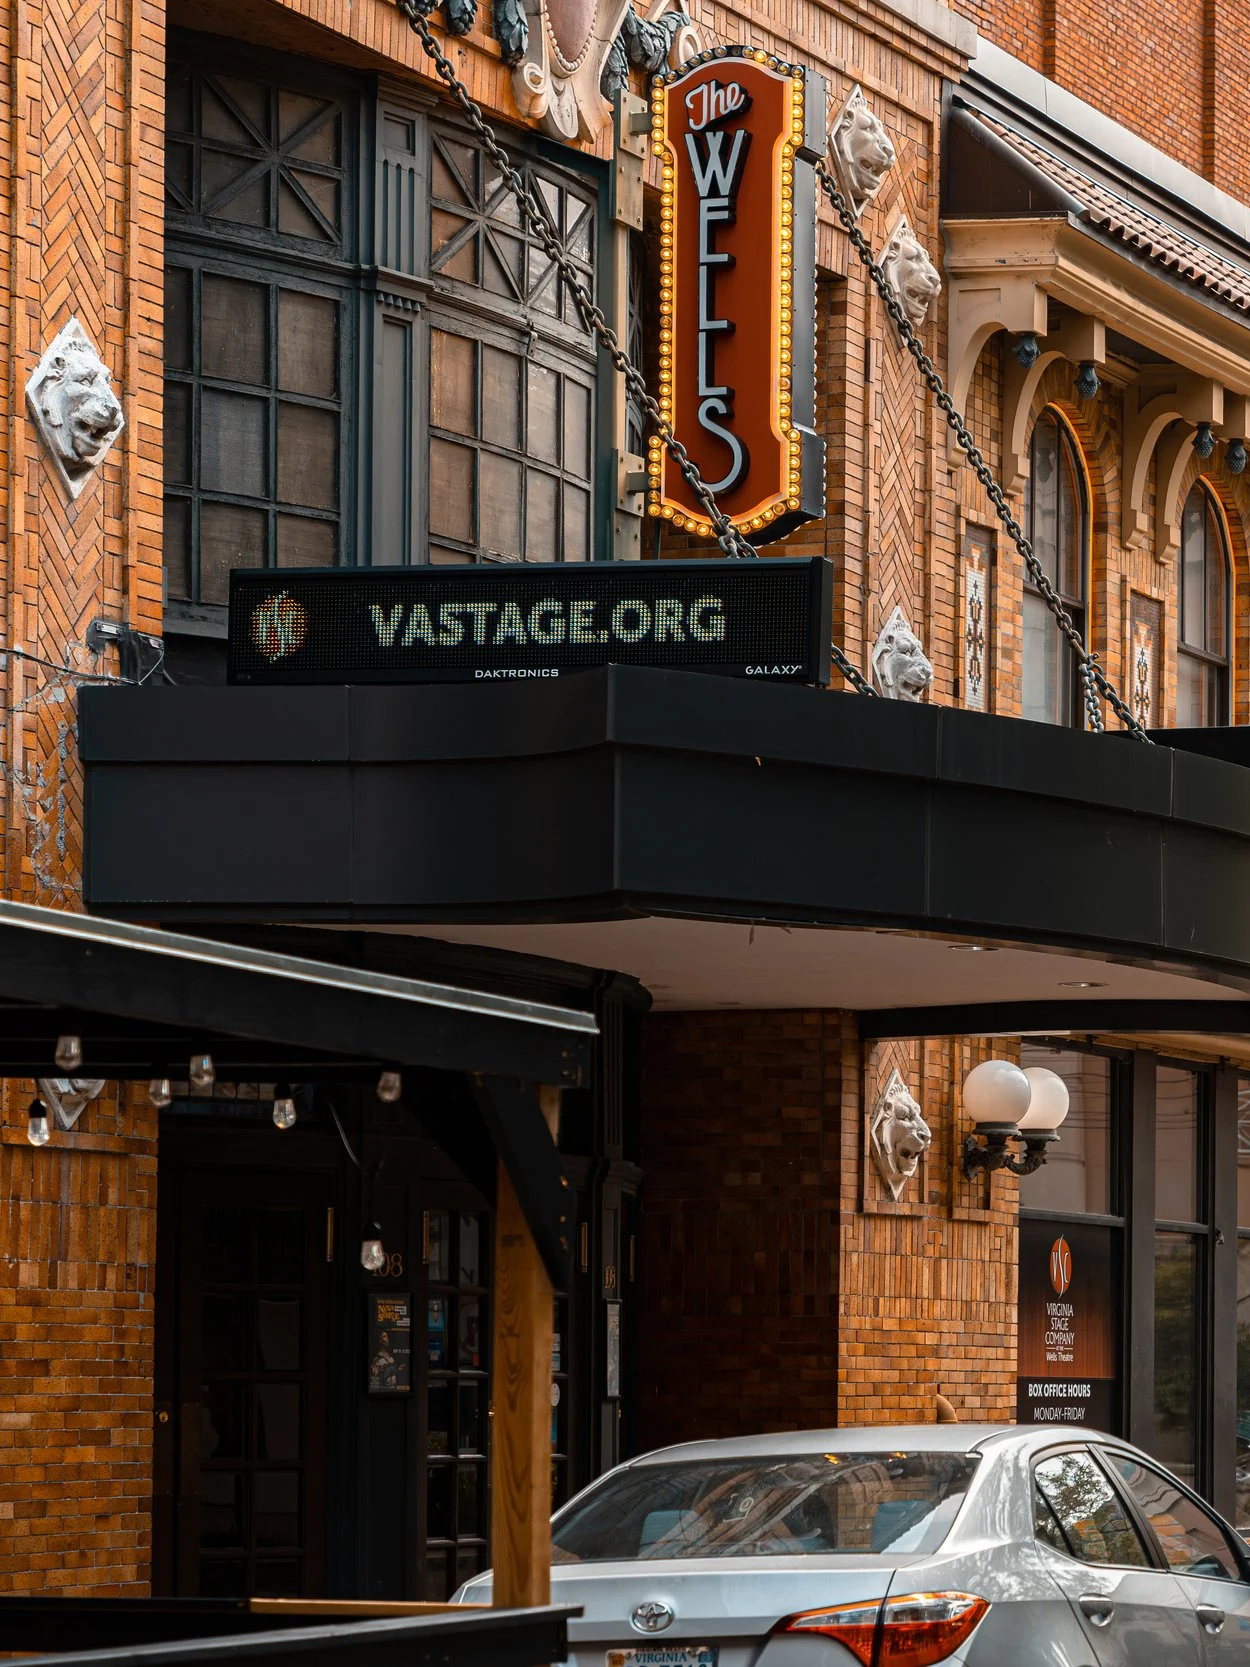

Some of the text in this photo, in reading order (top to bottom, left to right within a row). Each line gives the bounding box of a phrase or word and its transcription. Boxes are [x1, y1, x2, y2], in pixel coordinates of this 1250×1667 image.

[685, 80, 745, 130] The
[685, 129, 746, 493] WELLS
[369, 594, 726, 647] VASTAGE.ORG
[474, 668, 559, 679] DAKTRONICS
[1046, 1302, 1074, 1317] VIRGINIA
[1051, 1317, 1069, 1331] STAGE
[1045, 1331, 1075, 1345] COMPANY
[1046, 1352, 1074, 1362] Wells Theatre
[1028, 1383, 1091, 1397] BOX OFFICE HOURS
[1034, 1407, 1085, 1421] MONDAY-FRIDAY
[635, 1652, 687, 1663] VIRGINIA
